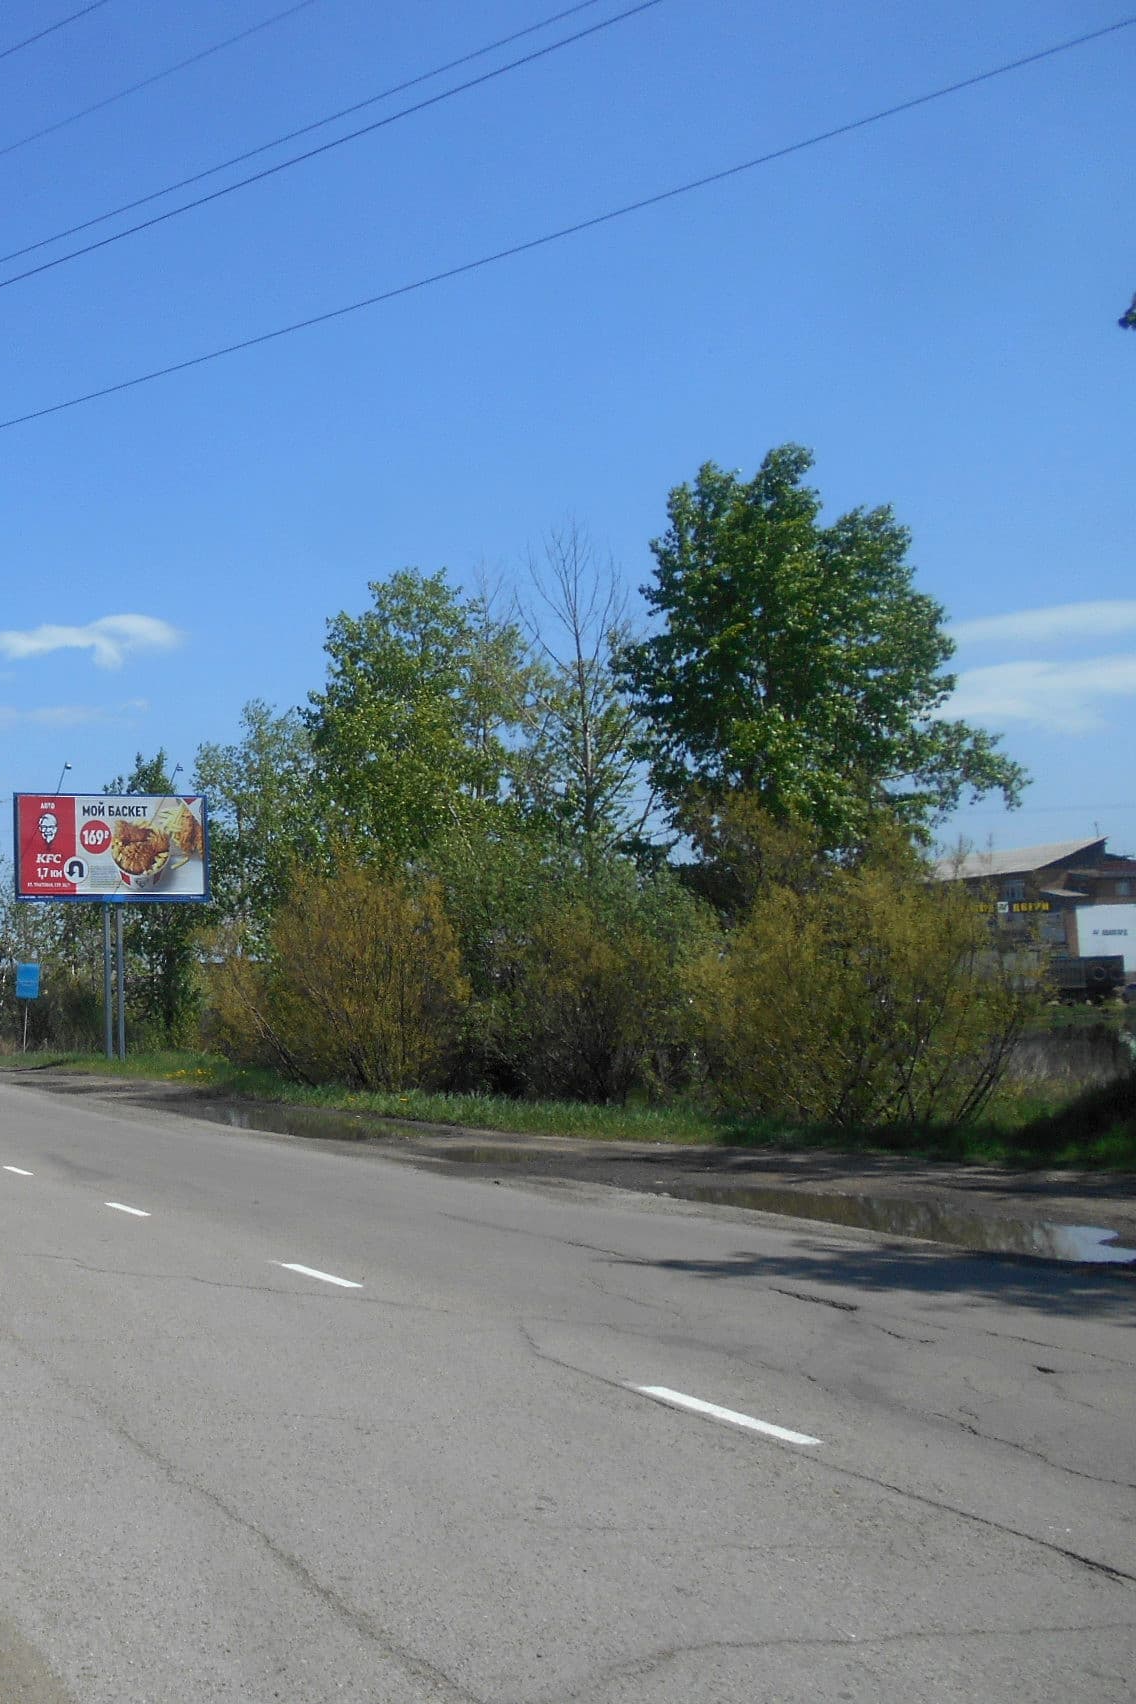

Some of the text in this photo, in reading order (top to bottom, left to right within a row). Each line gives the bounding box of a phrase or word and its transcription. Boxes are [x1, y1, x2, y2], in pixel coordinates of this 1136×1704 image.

[82, 801, 148, 817] МОЙ БАСКЕТ
[36, 853, 62, 864] KFC
